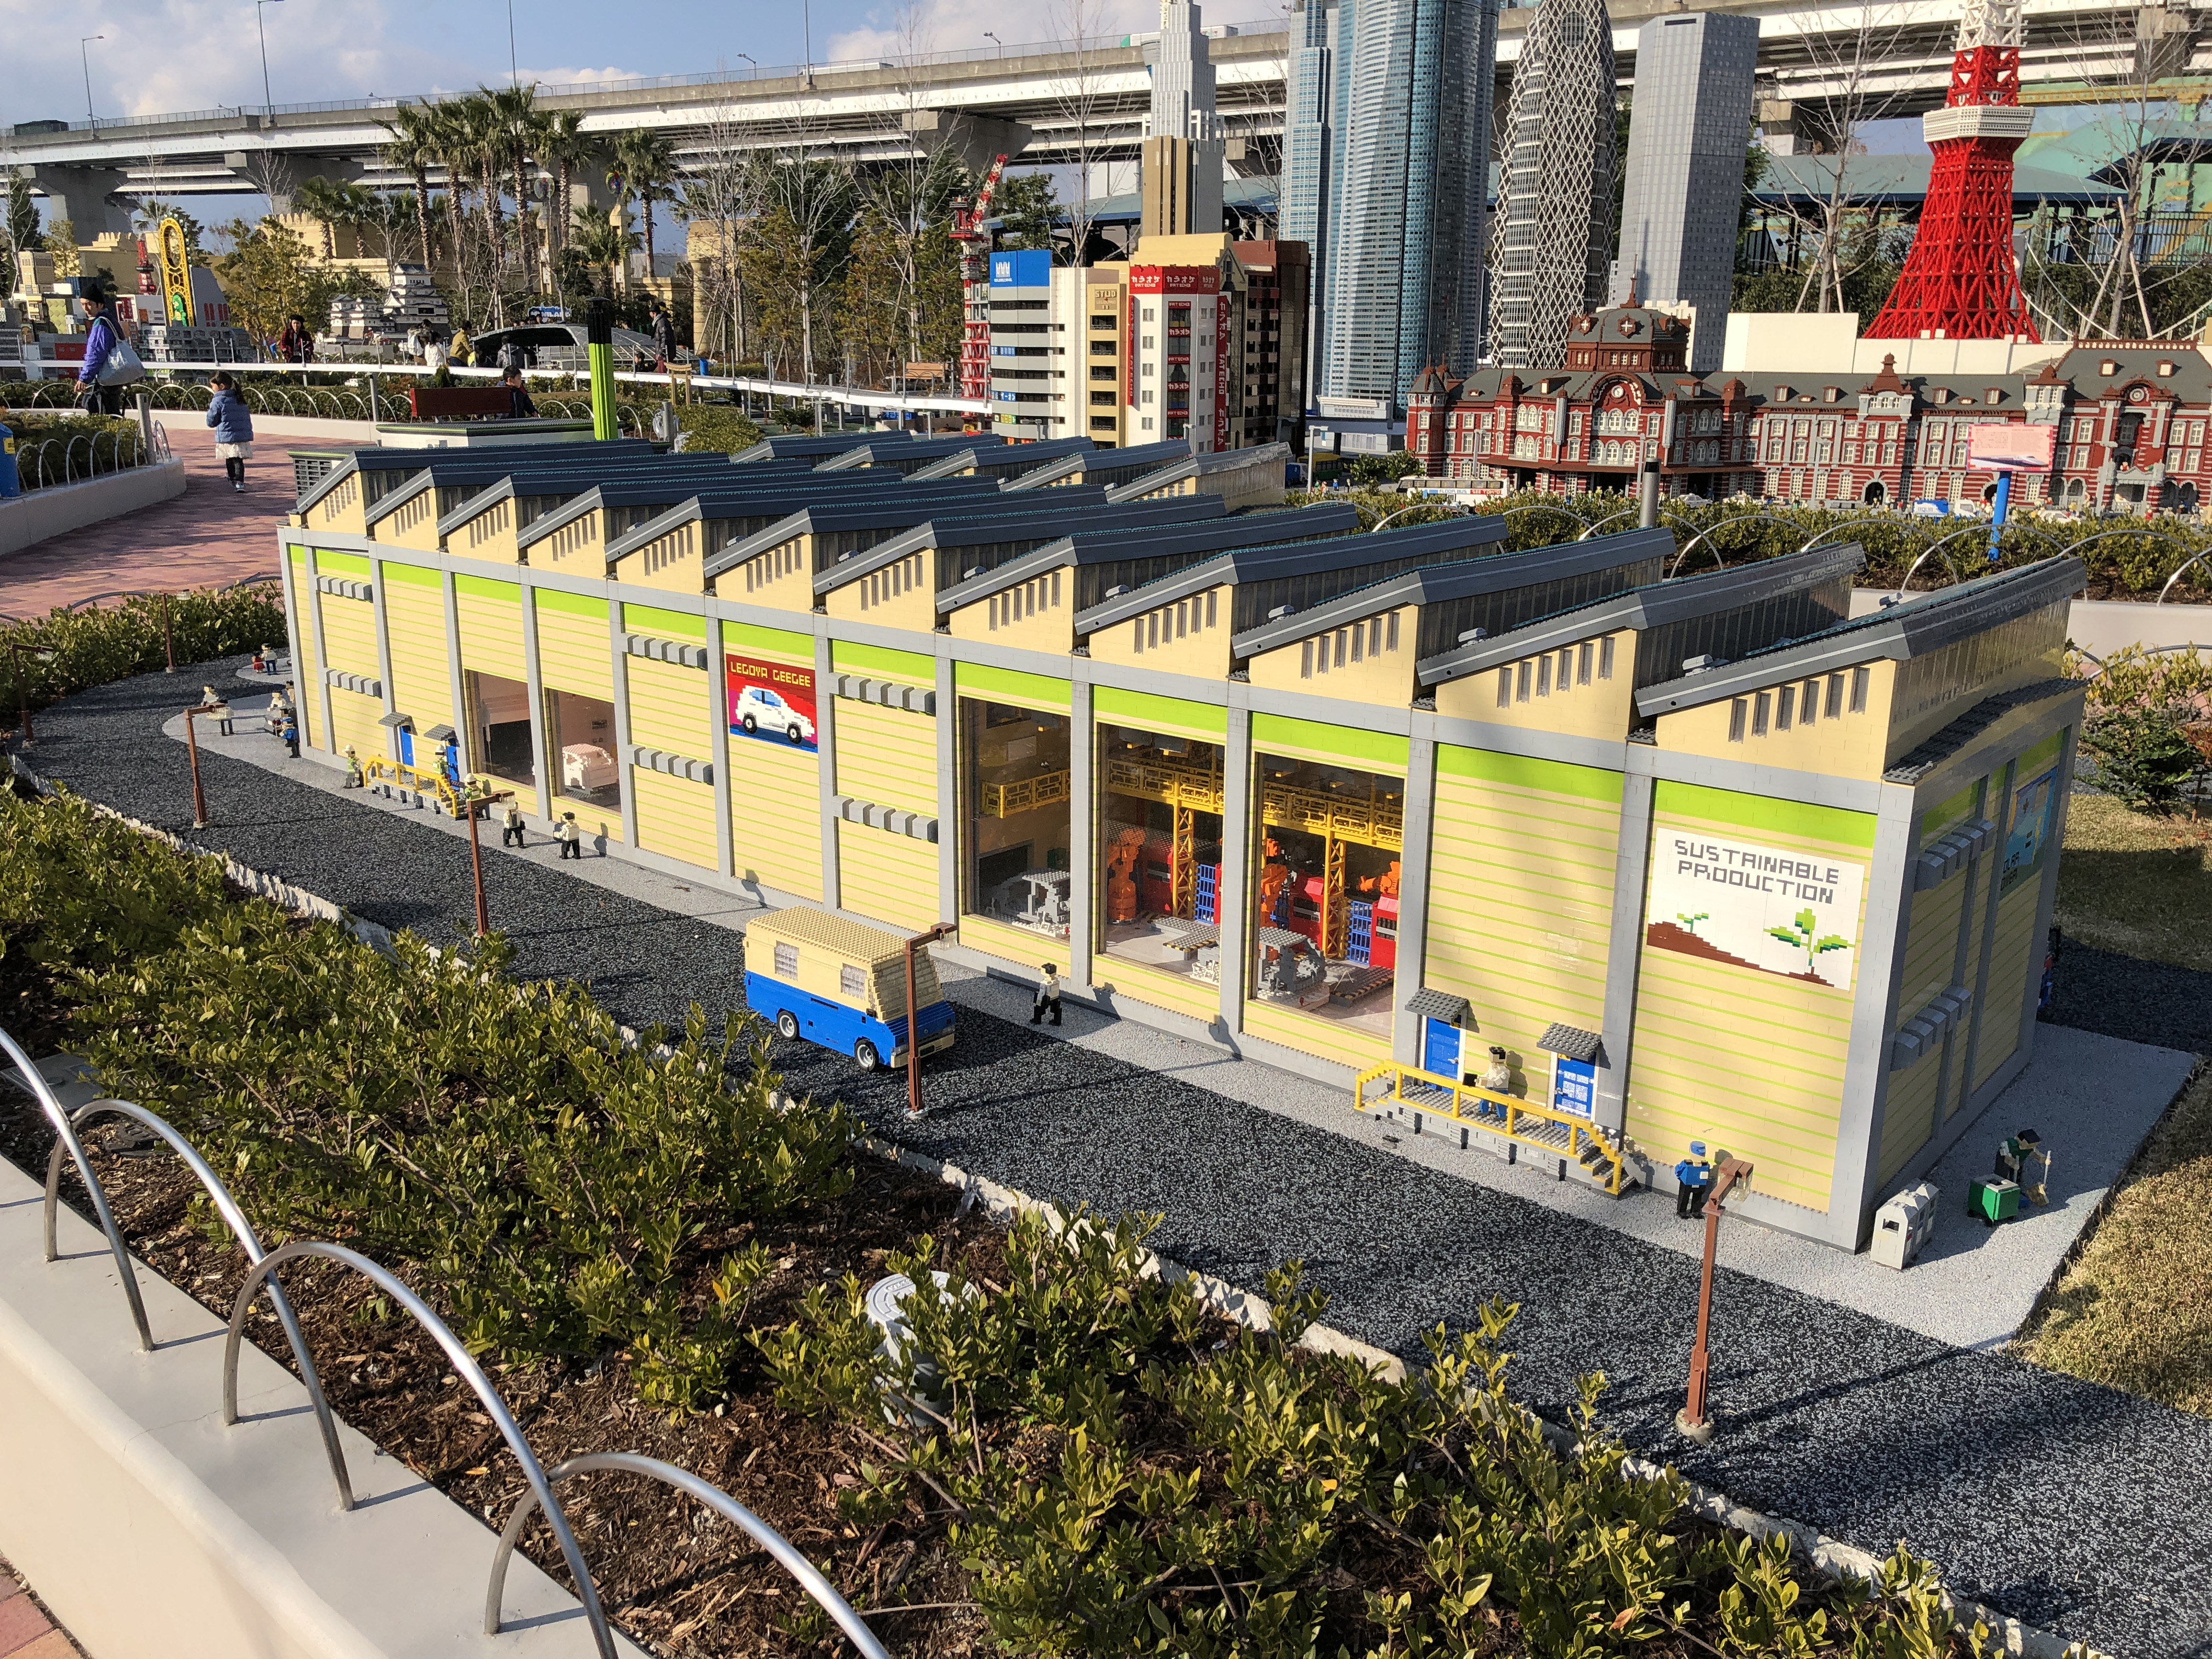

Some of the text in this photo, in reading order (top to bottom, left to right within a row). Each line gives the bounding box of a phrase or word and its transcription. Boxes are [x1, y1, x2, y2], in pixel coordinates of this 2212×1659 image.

[1219, 302, 1227, 340] カラオケ
[730, 661, 811, 687] LEGOYA GEEGEE
[1674, 839, 1839, 884] SUSTAINABLE
[2003, 851, 2019, 873] OLAR
[1678, 860, 1833, 904] PRODUCTION
